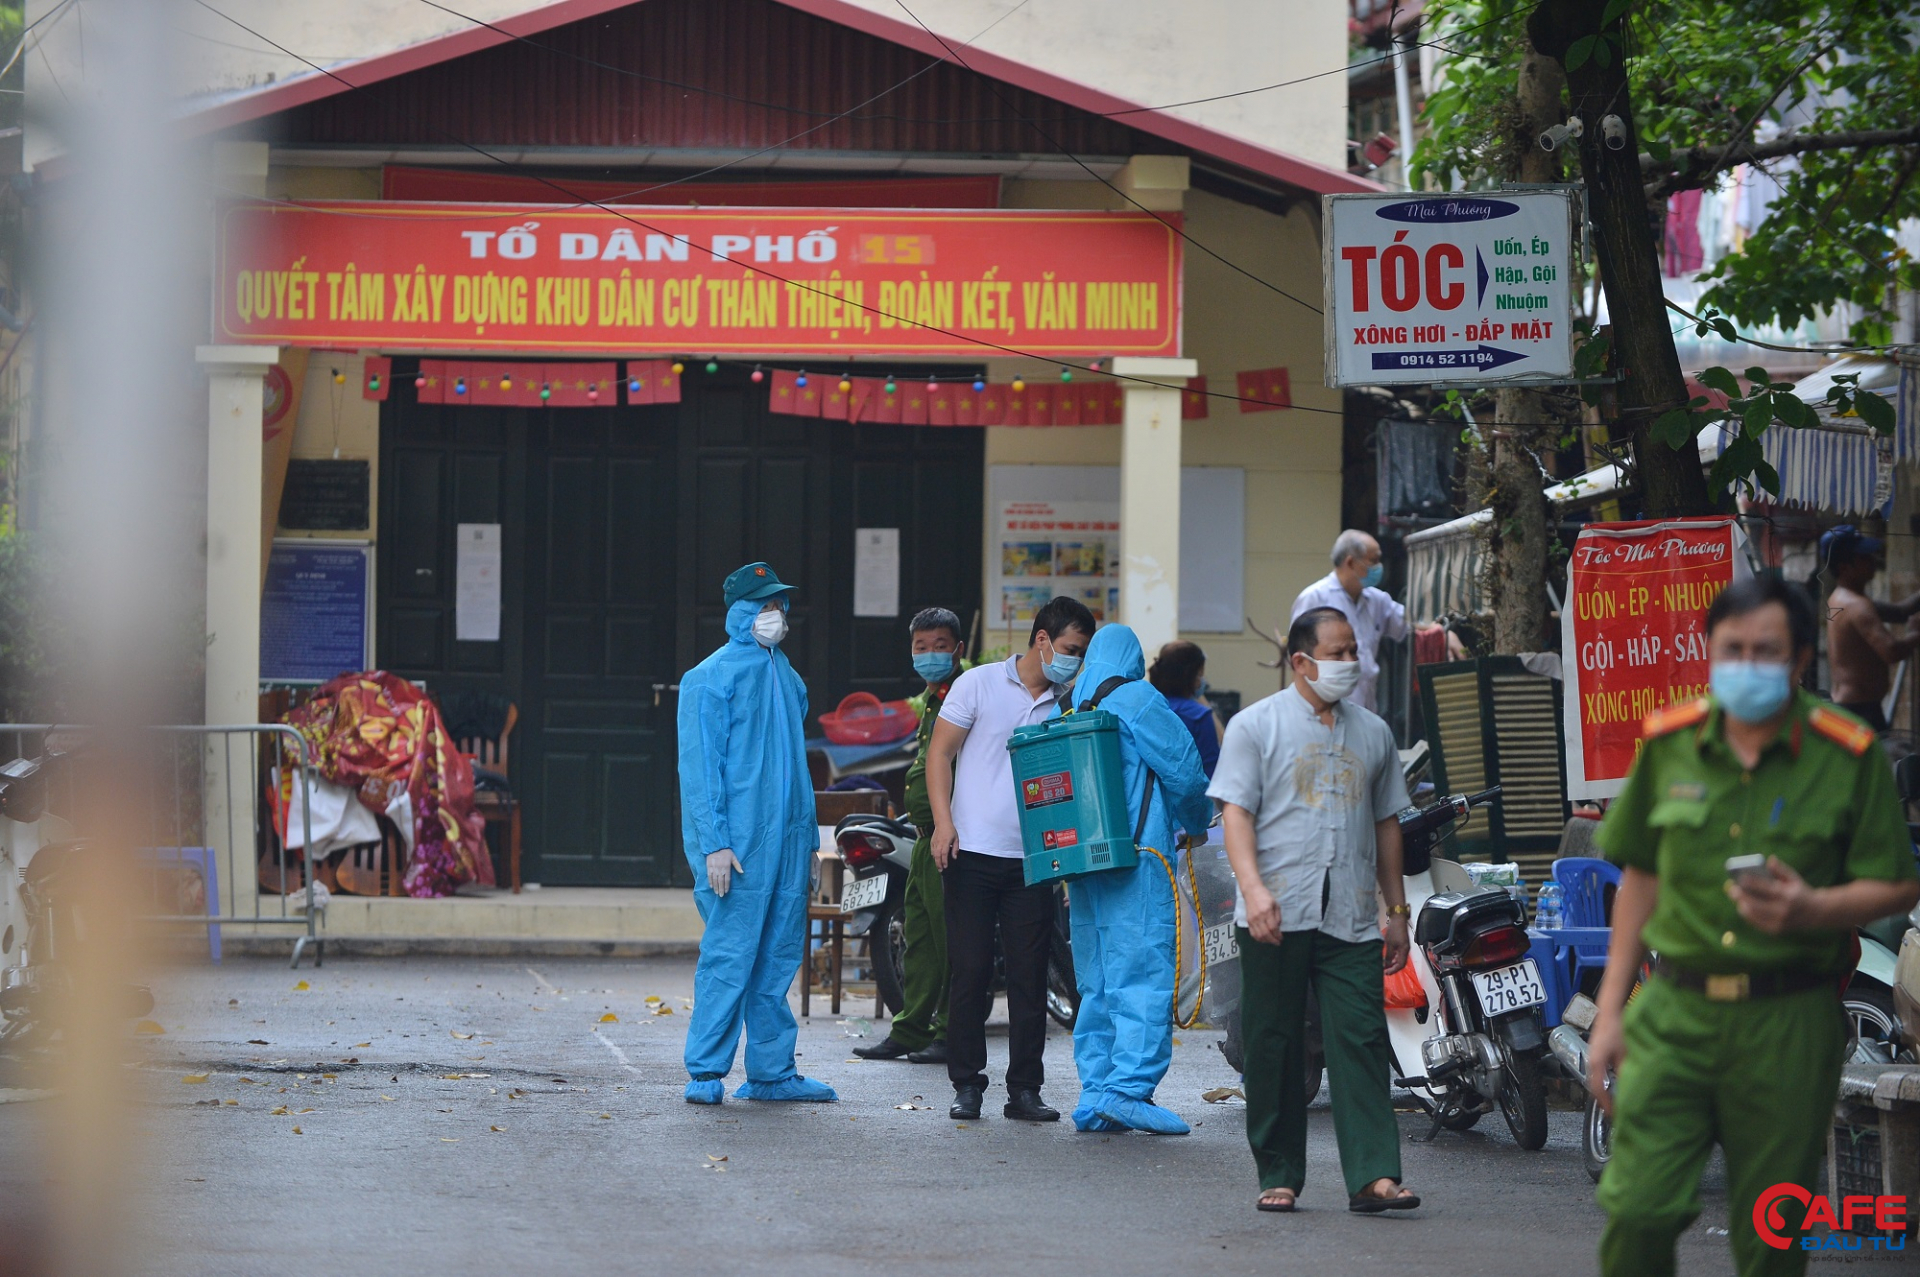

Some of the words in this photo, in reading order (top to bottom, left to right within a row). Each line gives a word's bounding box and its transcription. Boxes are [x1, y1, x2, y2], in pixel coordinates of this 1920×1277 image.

[1404, 203, 1437, 219] Mai
[461, 221, 541, 260] TỔ
[560, 228, 689, 262] DÂN
[711, 226, 840, 263] PHỐ
[863, 235, 923, 265] 15
[1494, 236, 1527, 256] Uốn,
[1531, 235, 1549, 256] Ép
[1341, 230, 1465, 313] TÓC
[1532, 265, 1556, 285] Gội
[236, 257, 319, 323] QUYẾT
[326, 262, 385, 322] TÂM
[393, 264, 446, 323] XÂY
[453, 270, 528, 335] DỰNG
[536, 277, 590, 326] KHU
[599, 268, 654, 327] DÂN
[662, 272, 703, 328] CƯ
[706, 269, 778, 328] THÂN
[784, 269, 871, 339] THIỆN,
[879, 271, 954, 330] ĐOÀN
[961, 265, 1015, 336] KẾT,
[1022, 272, 1078, 330] VĂN
[1086, 281, 1158, 330] MINH
[1496, 293, 1548, 312] Nhuộm
[1353, 324, 1407, 345] XÔNG
[1413, 324, 1445, 343] HƠI
[1465, 317, 1505, 342] ĐẮP
[1511, 318, 1553, 343] MẶT
[1400, 355, 1434, 366] 0914
[1439, 354, 1456, 365] 52
[1460, 352, 1494, 363] 1194
[1576, 546, 1611, 566] Tóc
[1659, 538, 1725, 561] Phương
[1578, 578, 1616, 620] UỐN
[1629, 579, 1649, 616] ÉP
[1582, 632, 1615, 677] GỘI
[1627, 624, 1661, 666] HẤP
[1674, 620, 1708, 662] SẤY
[1585, 682, 1628, 724] XÔNG
[1631, 685, 1655, 721] HƠI
[1055, 787, 1065, 797] 20
[843, 890, 880, 911] 682.21
[848, 877, 879, 897] 29-P1
[1205, 924, 1235, 948] 29-L
[1483, 964, 1529, 992] 29-P1
[1485, 983, 1543, 1013] 278.52
